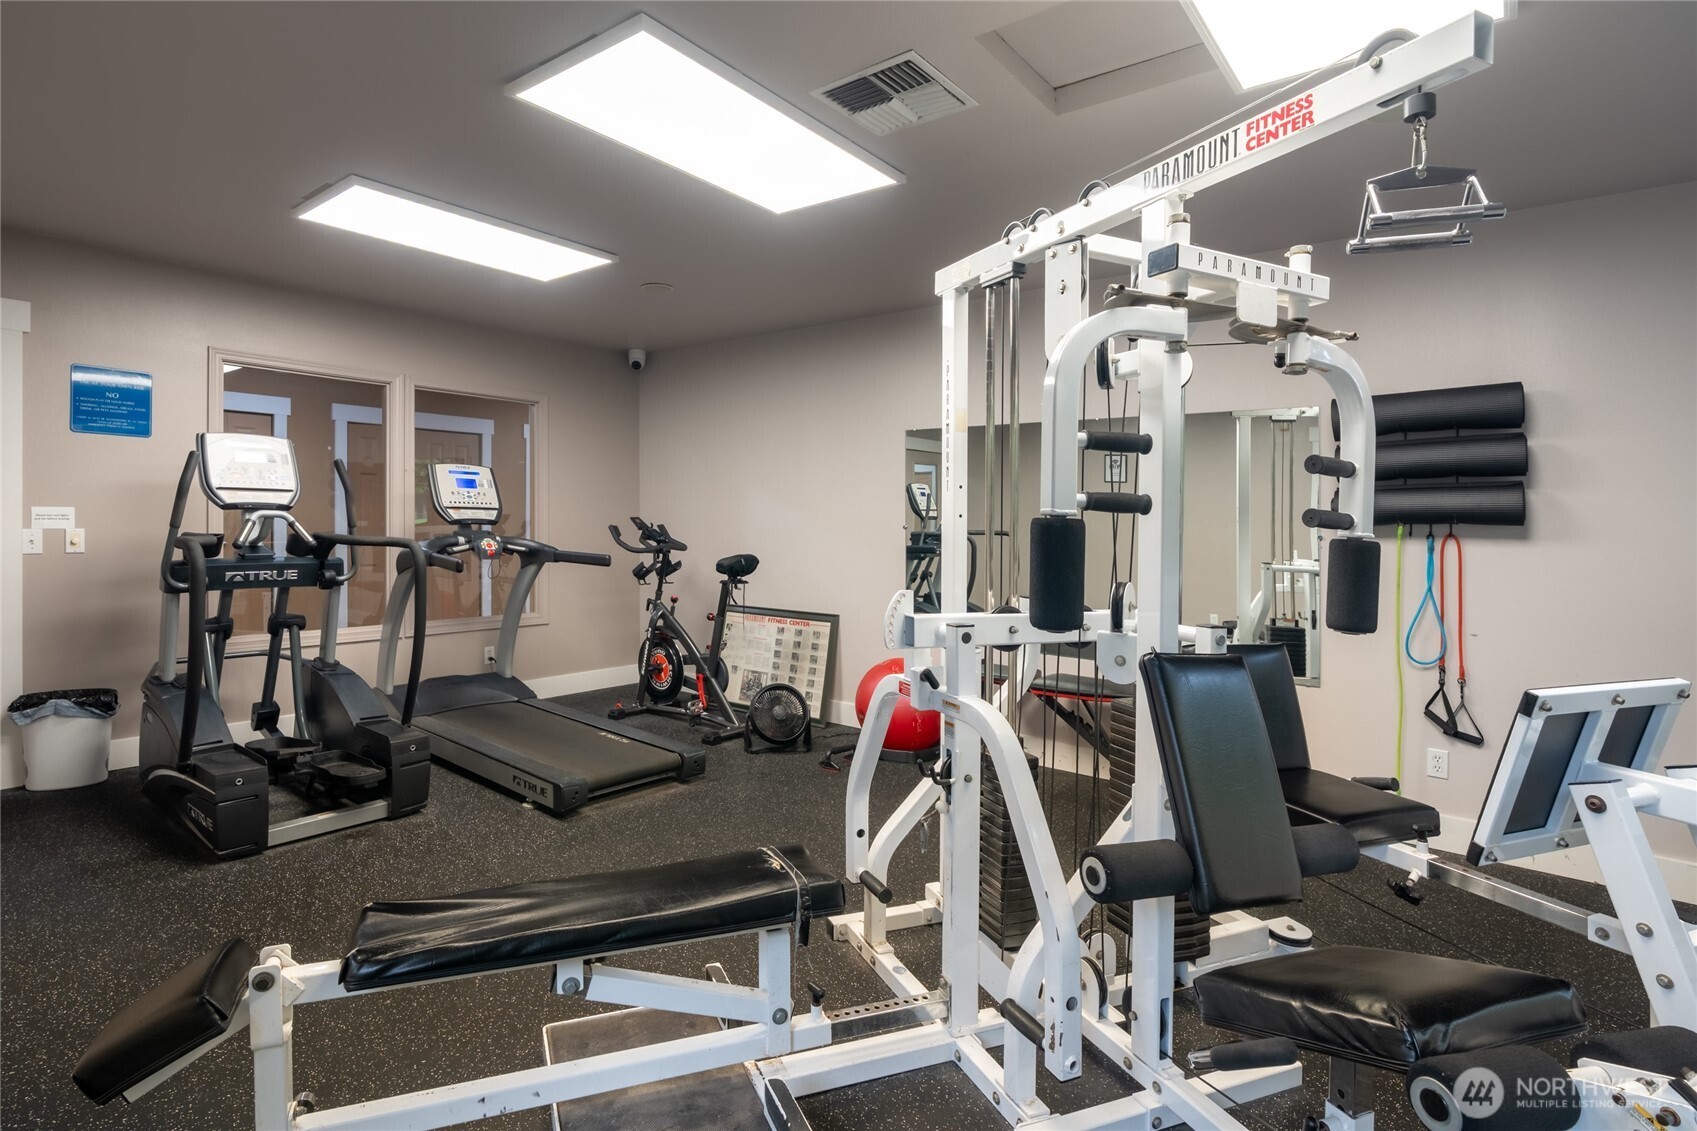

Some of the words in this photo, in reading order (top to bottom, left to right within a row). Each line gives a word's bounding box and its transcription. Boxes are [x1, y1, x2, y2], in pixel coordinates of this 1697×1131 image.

[1246, 93, 1314, 137] FITNESS
[1245, 110, 1315, 152] CENTER
[1143, 127, 1240, 194] PARAMOUNT
[1198, 252, 1315, 292] PARAMOUNT
[105, 391, 119, 399] NO
[245, 570, 298, 581] TRUE
[767, 617, 788, 625] FITNESS
[789, 620, 811, 628] CENTER
[522, 779, 548, 799] TRUE
